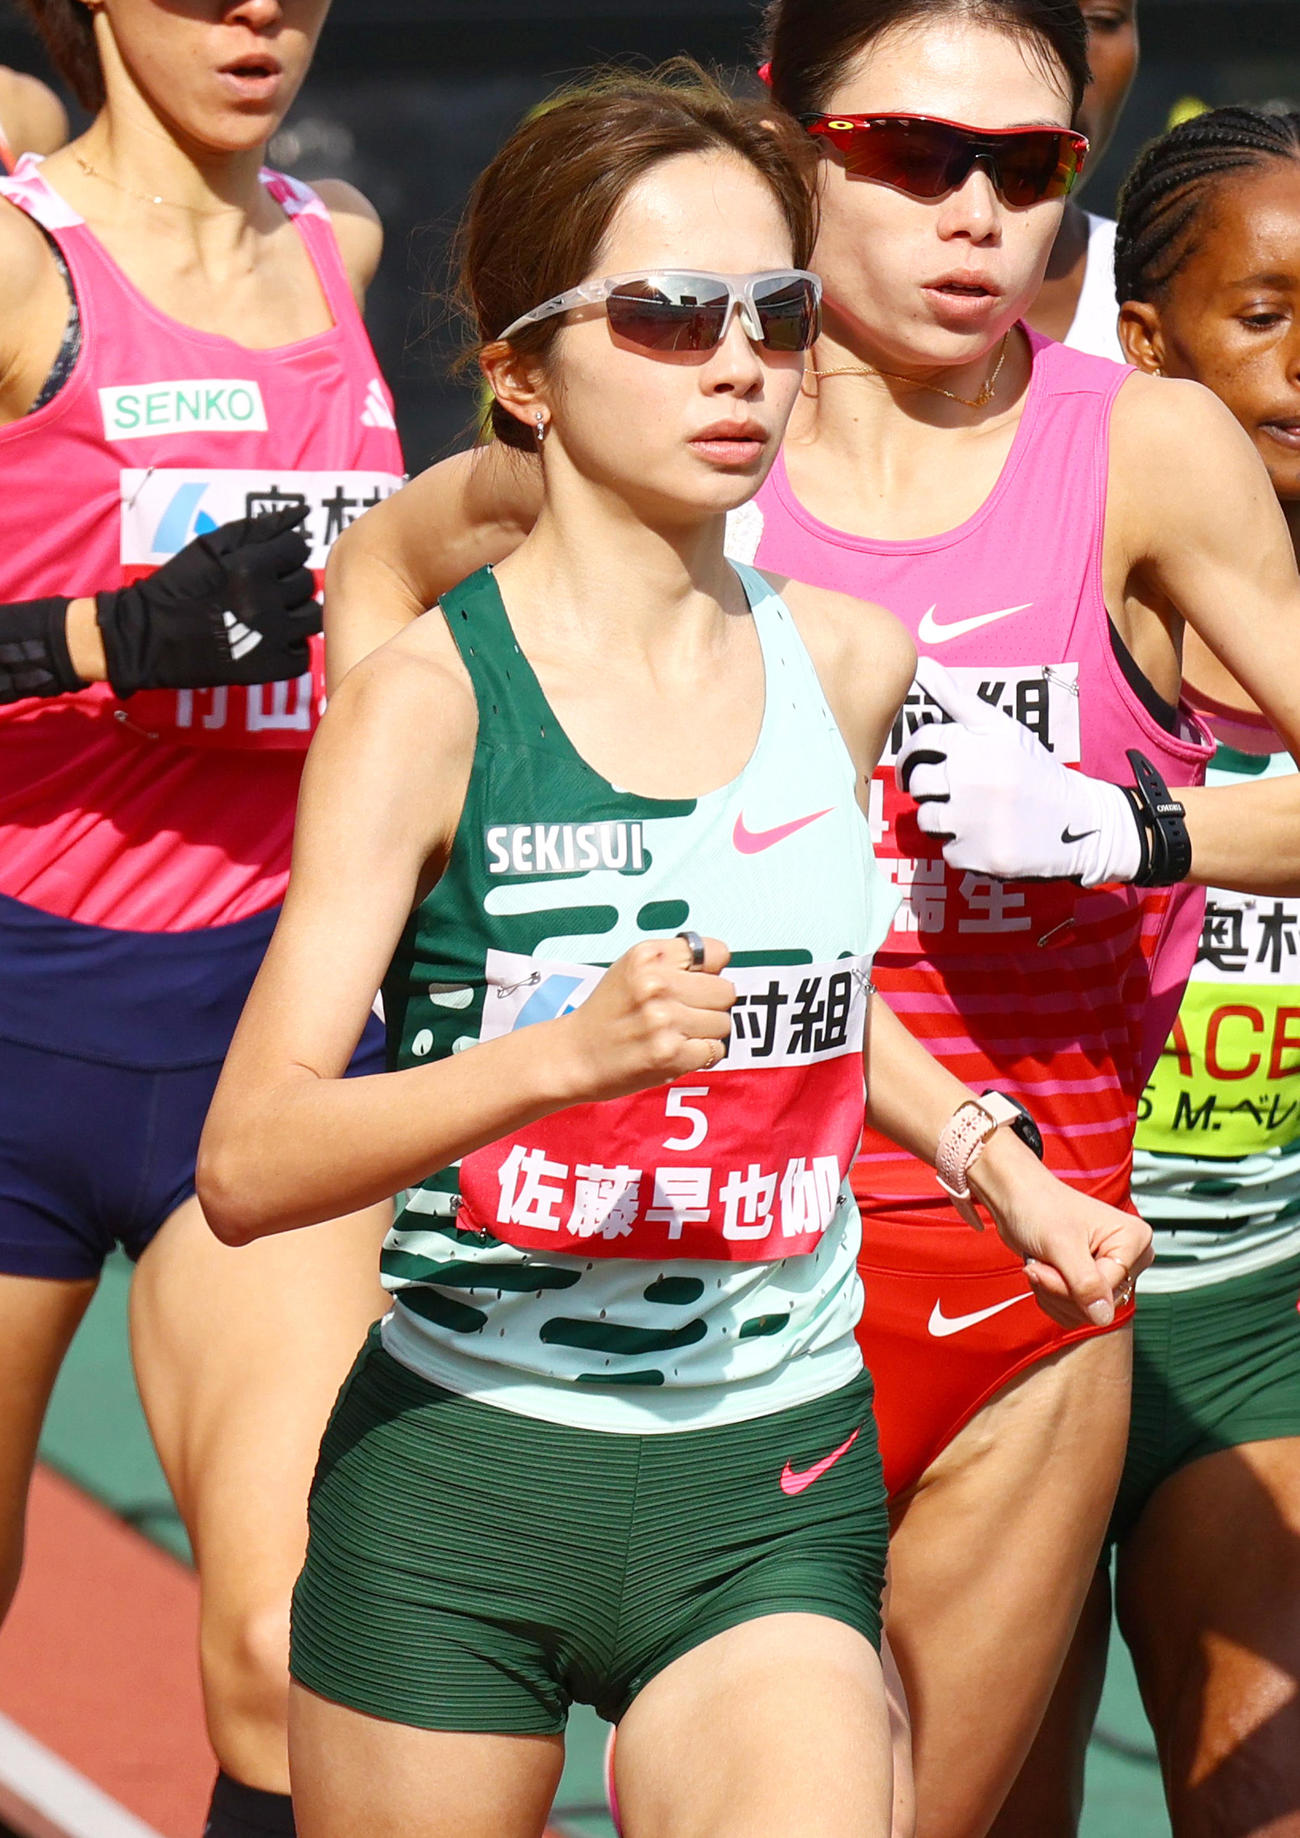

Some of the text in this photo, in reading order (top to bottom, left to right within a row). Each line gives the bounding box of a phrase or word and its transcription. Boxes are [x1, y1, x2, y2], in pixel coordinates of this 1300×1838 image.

[114, 387, 254, 429] SENKO
[486, 822, 644, 873] SEKISUI
[661, 1086, 710, 1151] 5
[497, 1144, 841, 1241] 佐藤早也伽
